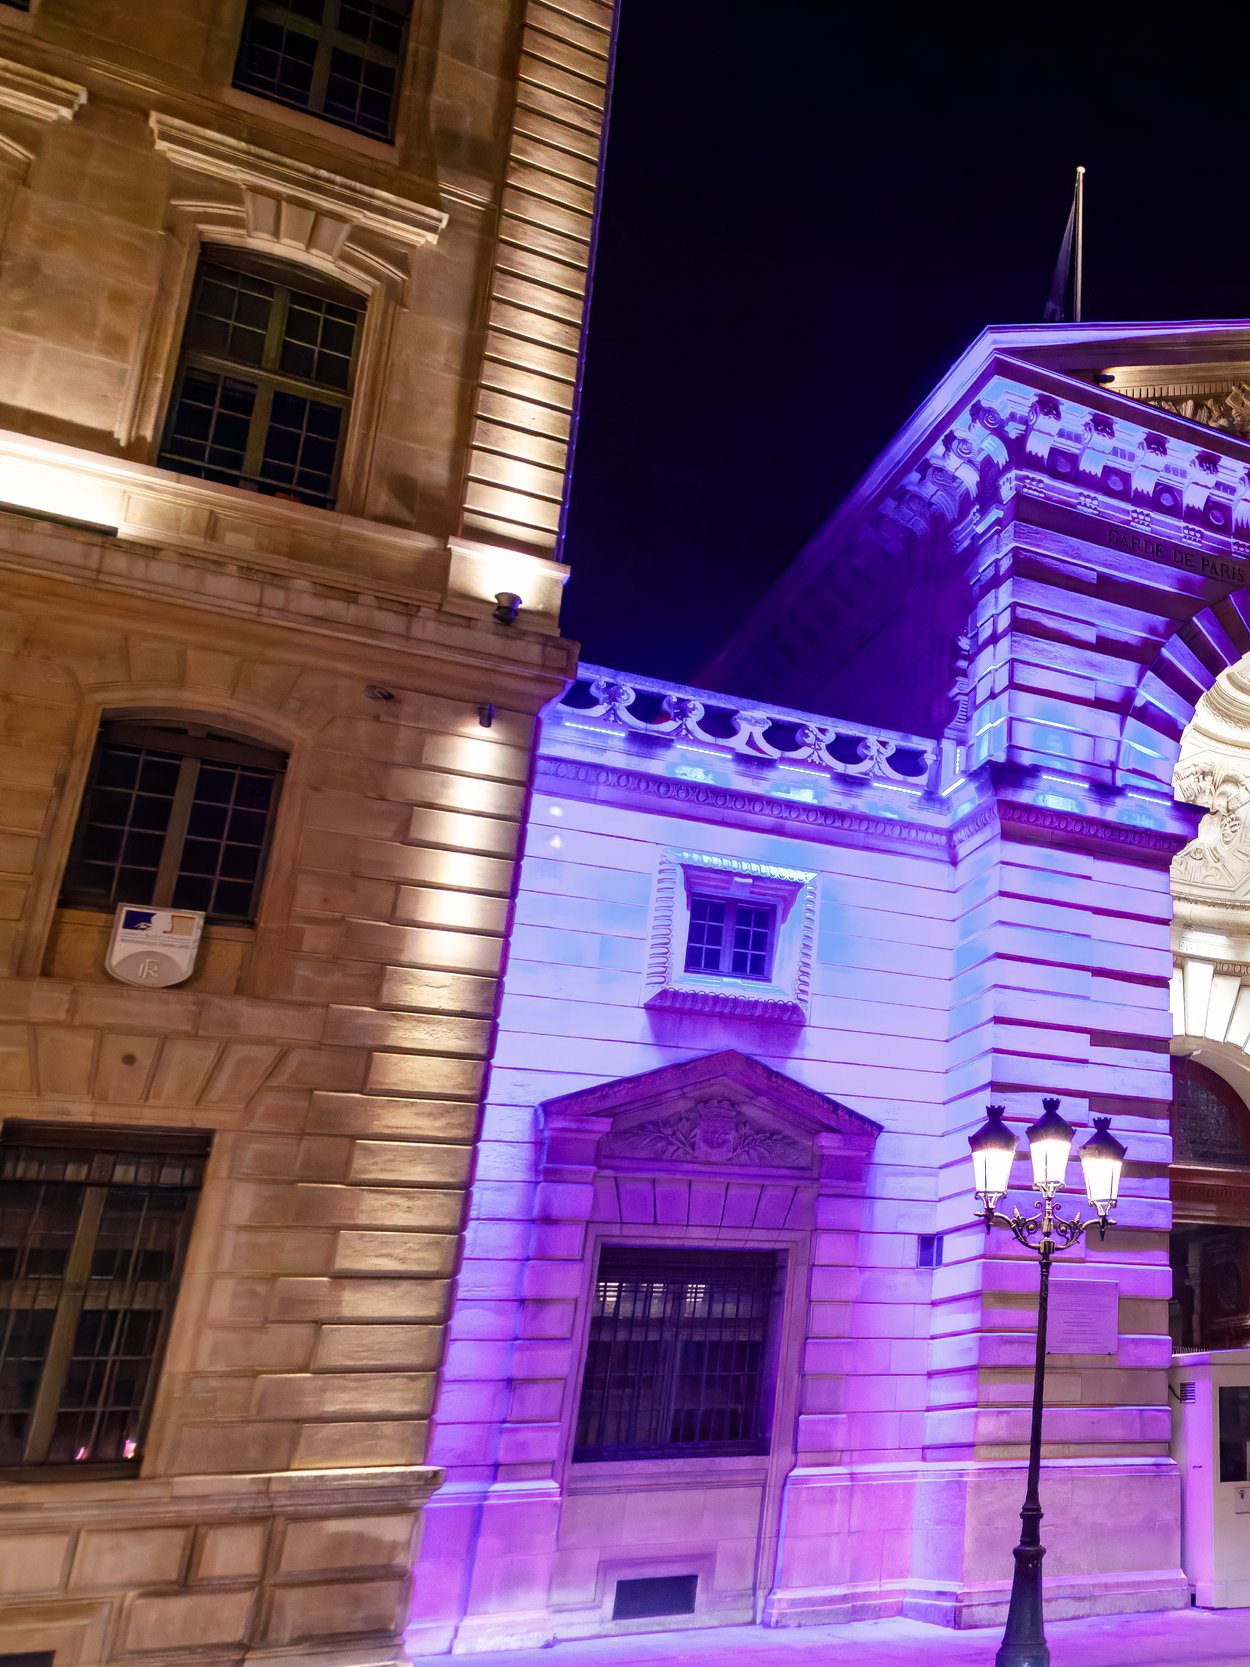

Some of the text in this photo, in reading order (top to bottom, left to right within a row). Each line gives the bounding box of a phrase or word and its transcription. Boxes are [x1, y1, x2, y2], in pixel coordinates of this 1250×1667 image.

[1108, 530, 1245, 582] GARDE DE PARIS
